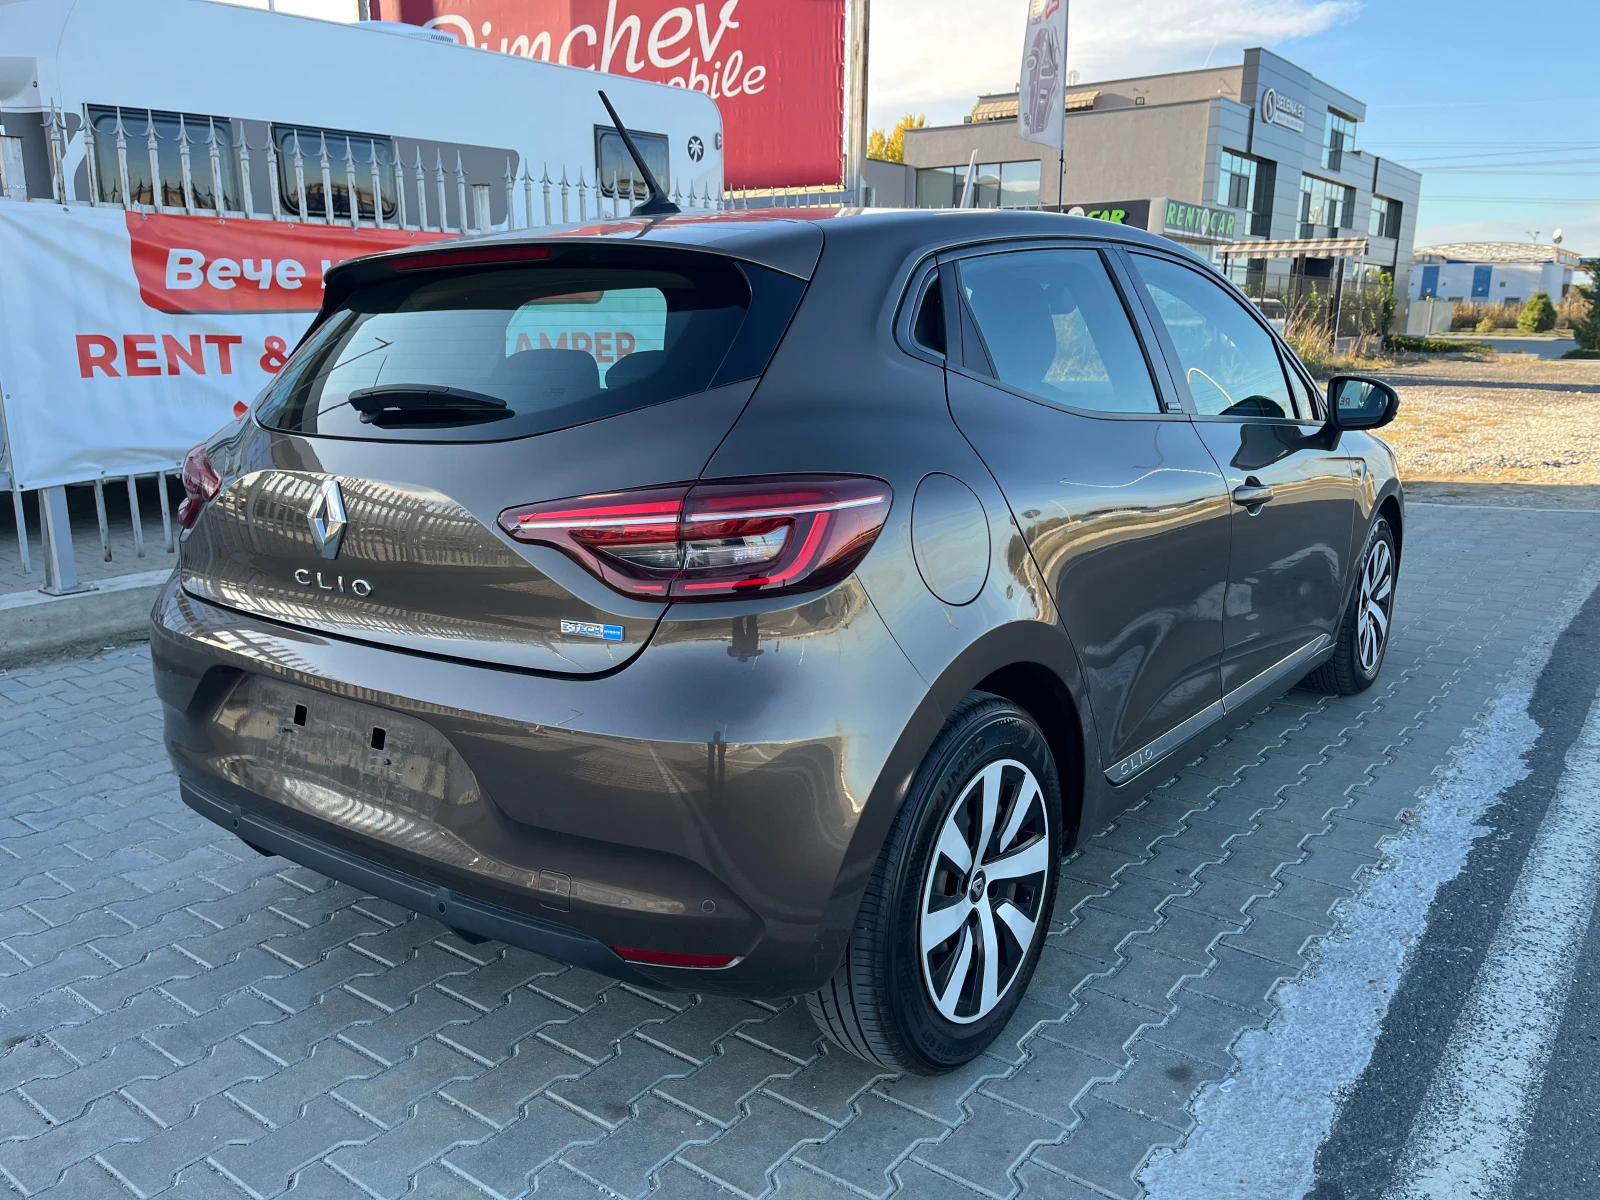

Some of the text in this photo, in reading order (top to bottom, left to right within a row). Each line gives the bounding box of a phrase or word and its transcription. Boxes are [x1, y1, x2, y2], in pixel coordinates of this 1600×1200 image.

[1166, 202, 1202, 229] RENT
[165, 248, 305, 290] Вече
[75, 332, 636, 378] RENT & AMPER
[294, 568, 373, 597] CLIO
[562, 623, 601, 636] E-TECH
[934, 736, 986, 812] KUMHO
[1120, 748, 1153, 776] CLIO
